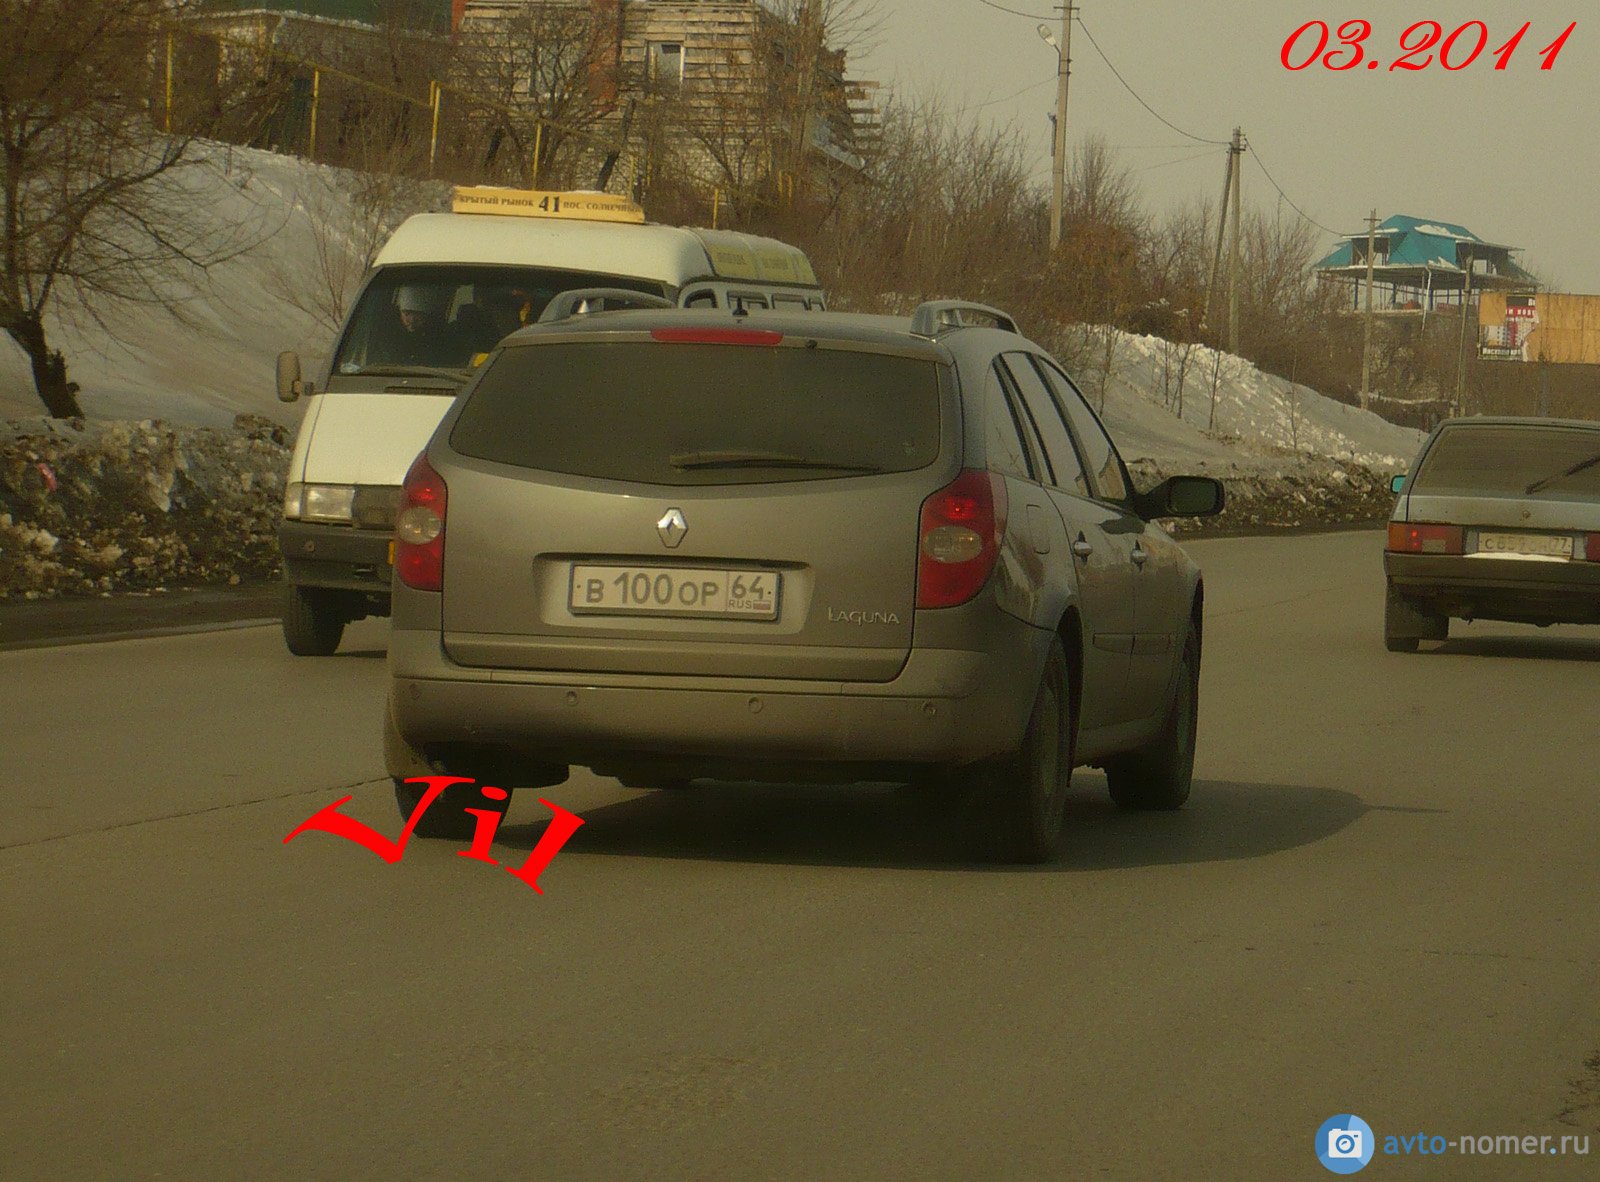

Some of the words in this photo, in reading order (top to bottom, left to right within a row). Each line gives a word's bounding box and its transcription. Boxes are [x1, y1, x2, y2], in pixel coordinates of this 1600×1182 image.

[501, 197, 534, 207] РЫНОК
[538, 196, 560, 213] 41
[731, 575, 764, 599] 64
[728, 599, 752, 609] RUS
[828, 606, 900, 625] LAGUNA
